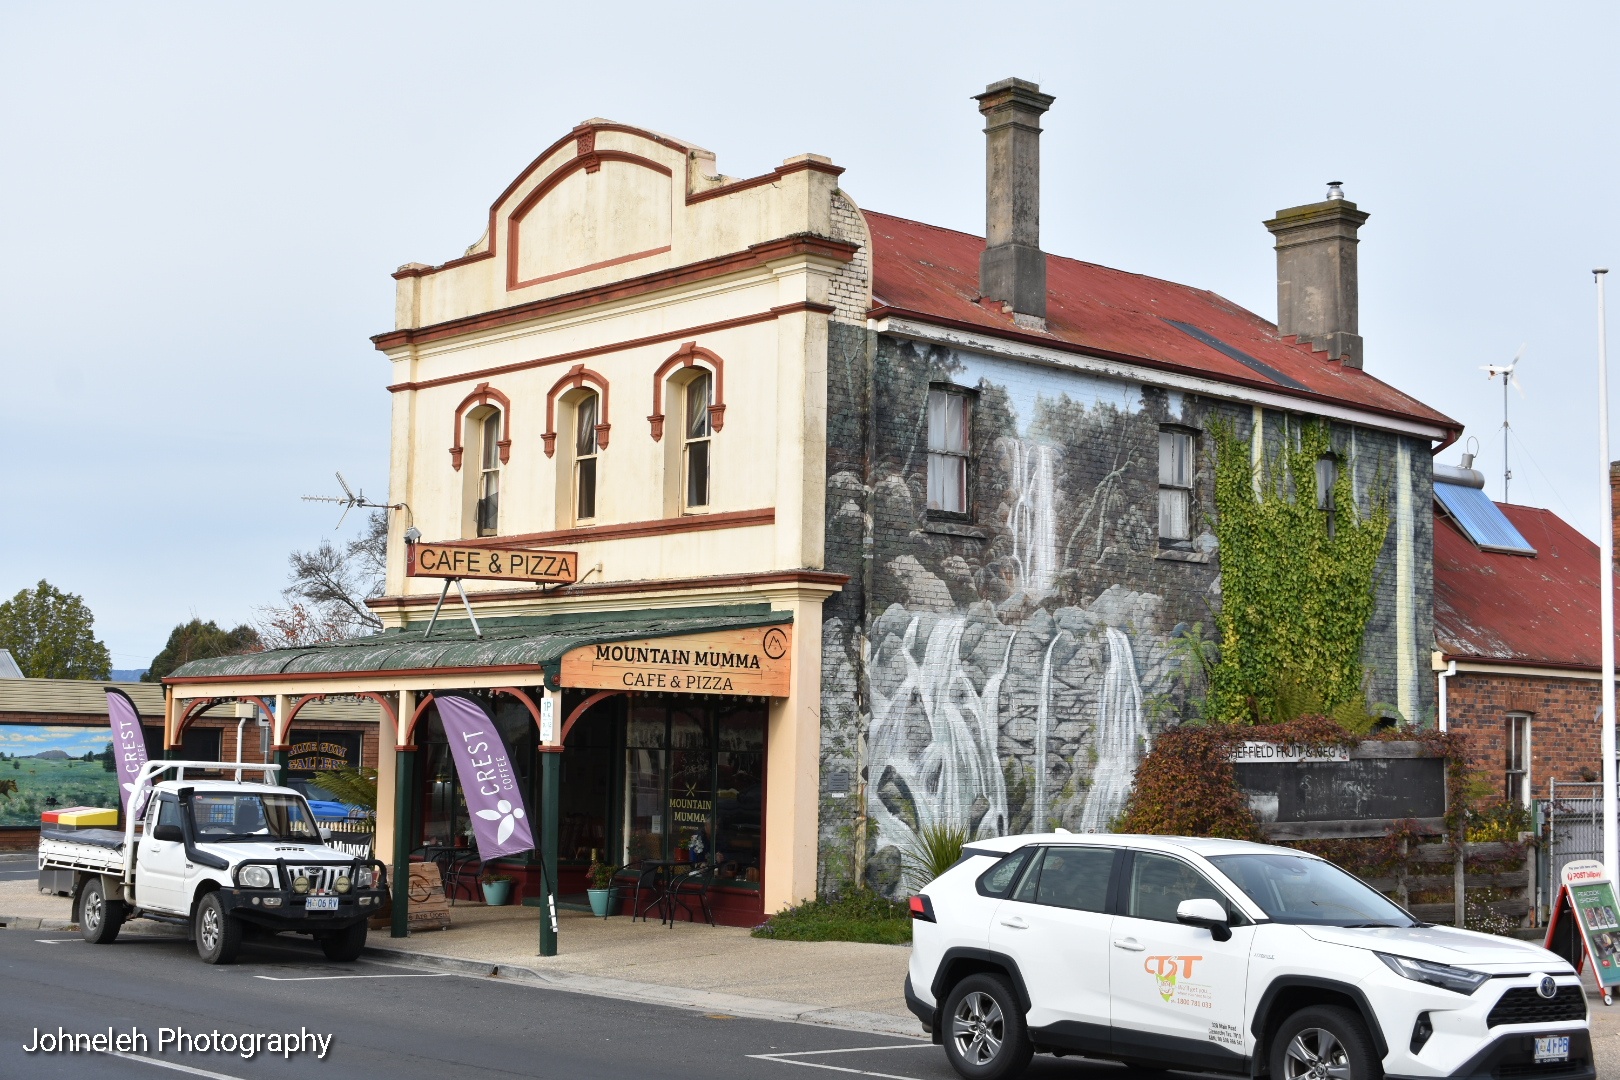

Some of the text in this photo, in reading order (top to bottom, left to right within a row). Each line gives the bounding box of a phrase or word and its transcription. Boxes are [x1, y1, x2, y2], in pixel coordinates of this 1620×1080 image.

[420, 549, 571, 577] CAFE & PIZZA
[595, 645, 761, 669] MOUNTAIN MUMMA
[622, 672, 734, 691] CAFE & PIZZA
[119, 721, 139, 773] CREST
[136, 743, 147, 769] OFFEE
[319, 742, 347, 758] GUM
[1276, 745, 1302, 758] FRUIT
[1305, 745, 1313, 757] &
[462, 731, 500, 796] CREST
[496, 755, 513, 790] COFFEE
[669, 798, 712, 810] MOUNTAIN
[674, 812, 706, 823] MUMMA
[333, 840, 369, 860] MUMMA
